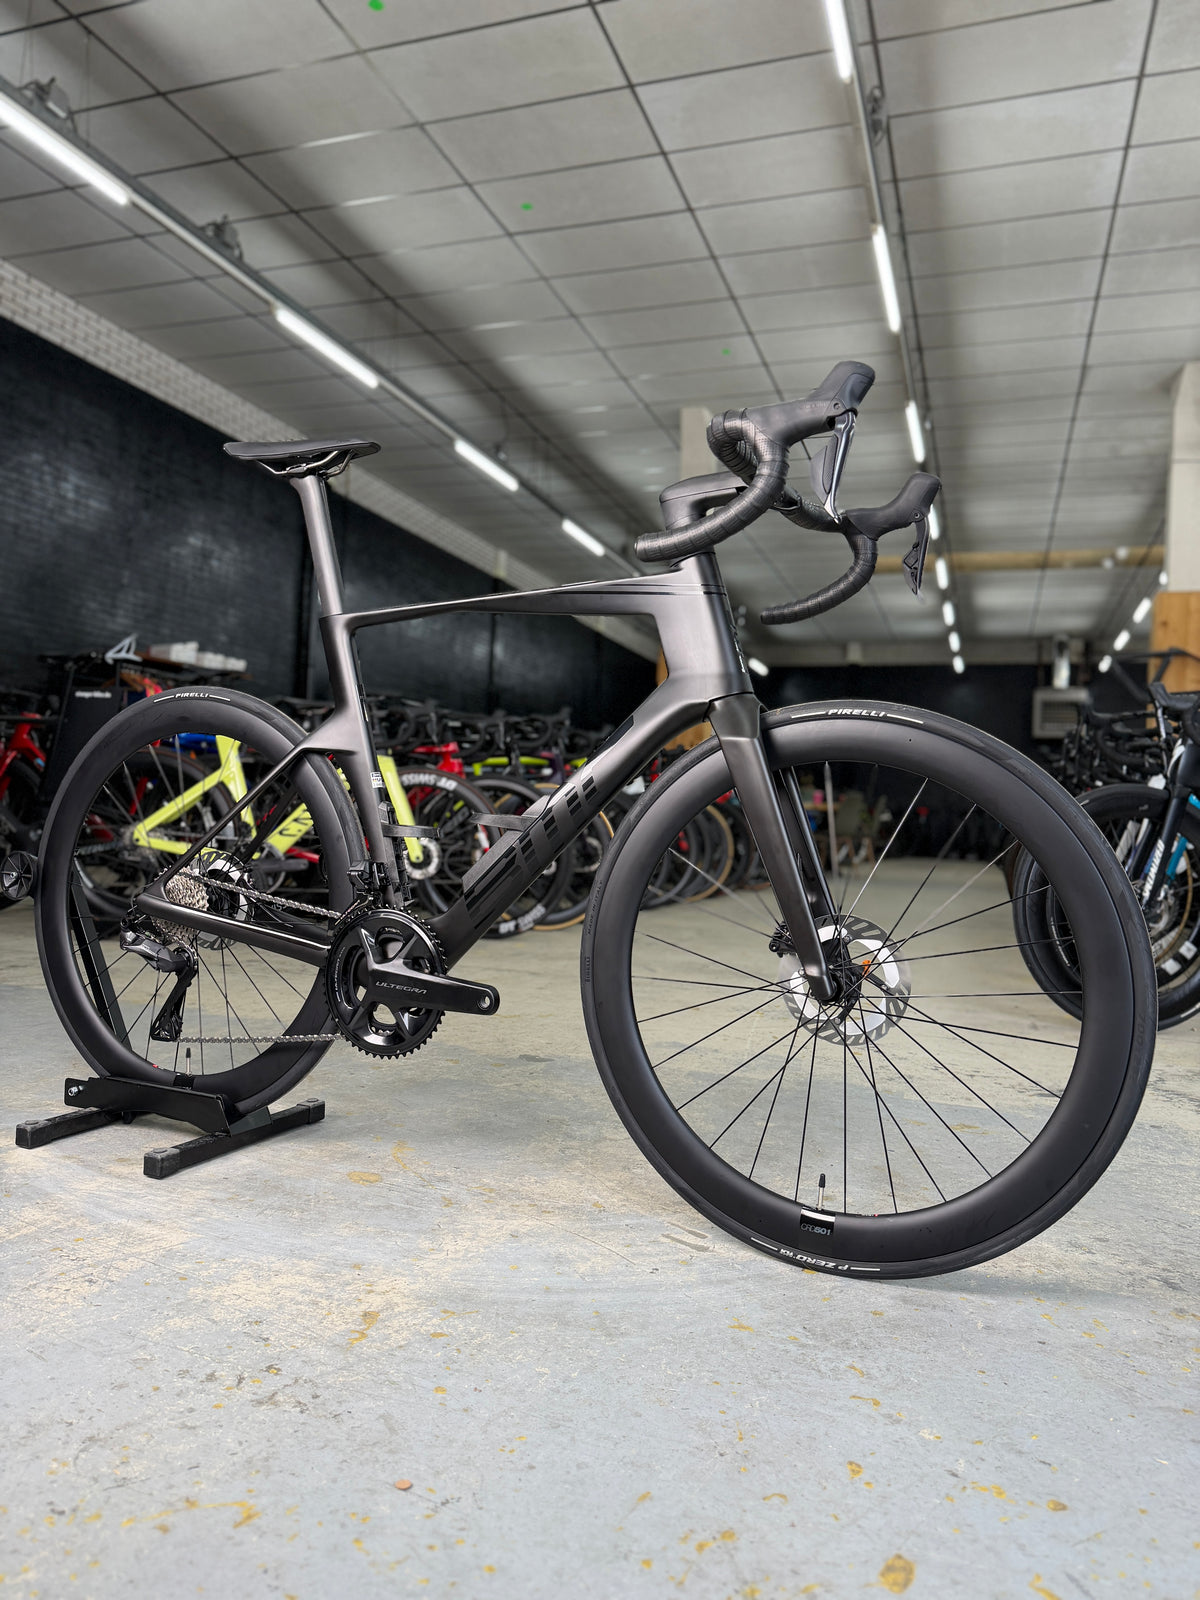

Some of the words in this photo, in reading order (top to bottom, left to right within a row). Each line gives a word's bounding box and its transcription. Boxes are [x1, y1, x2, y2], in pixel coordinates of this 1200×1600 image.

[828, 708, 886, 717] PIRELLI
[375, 981, 428, 995] ULTEGRA
[796, 1254, 837, 1269] ZERO
